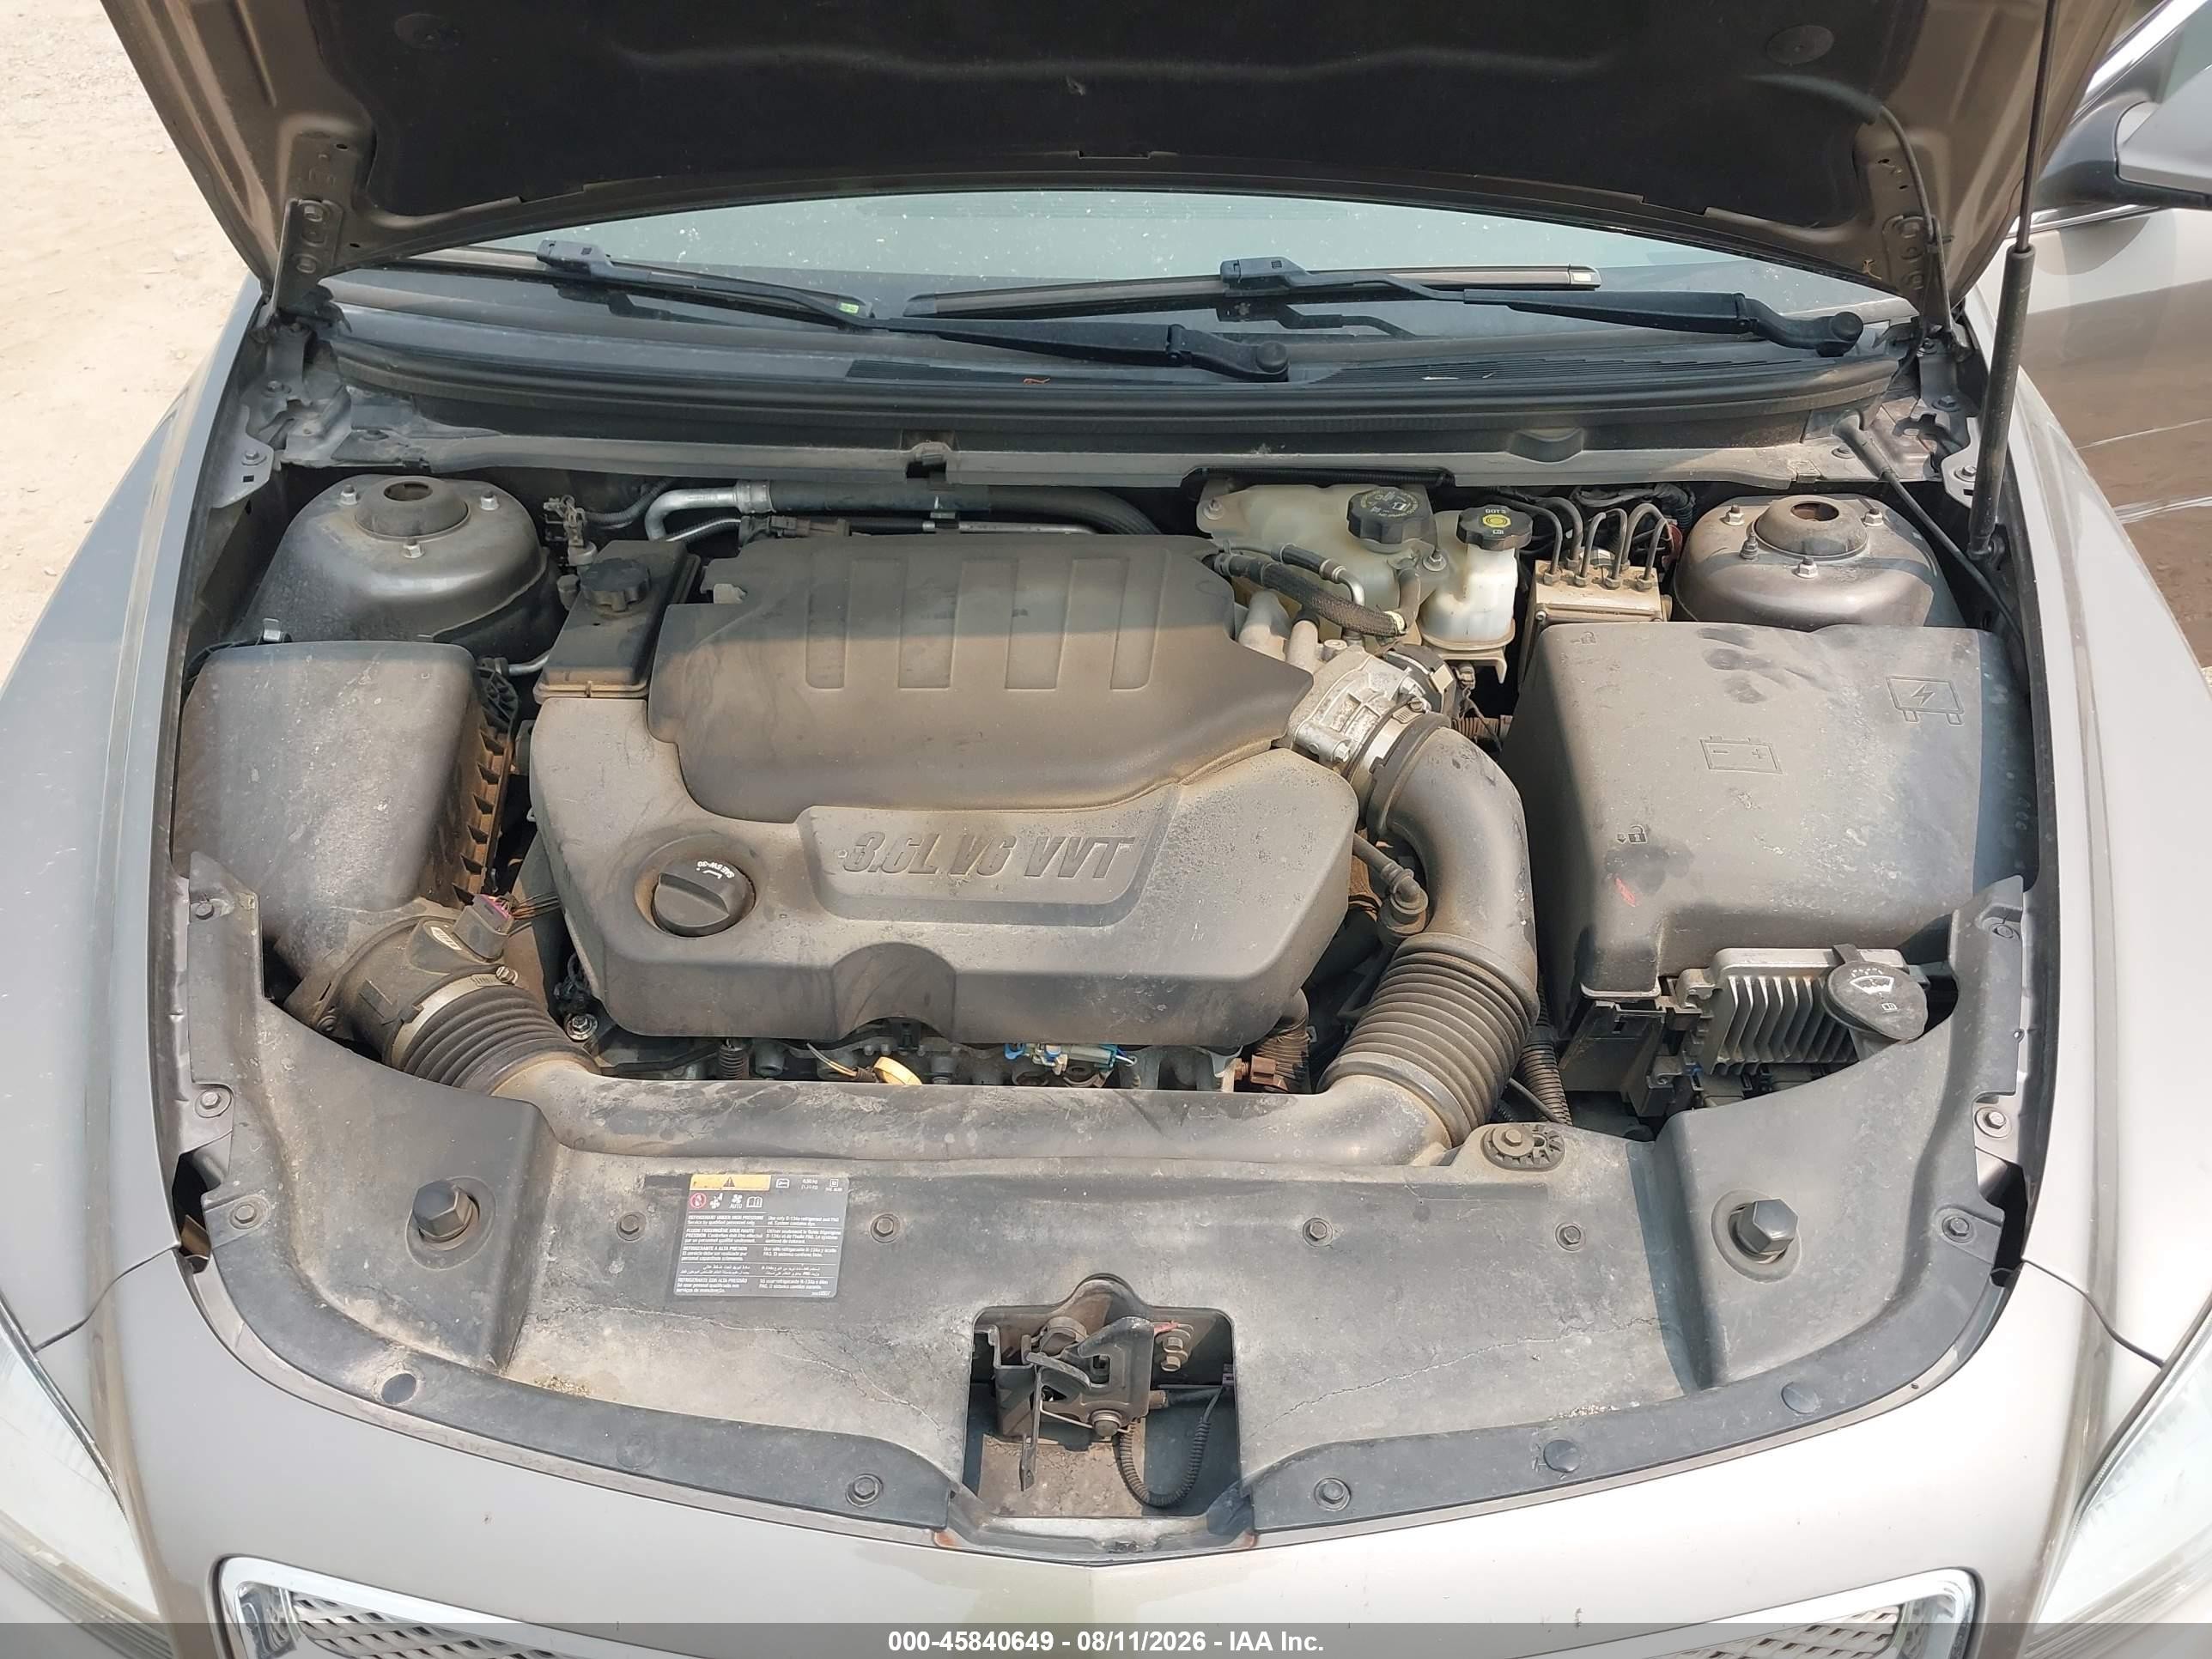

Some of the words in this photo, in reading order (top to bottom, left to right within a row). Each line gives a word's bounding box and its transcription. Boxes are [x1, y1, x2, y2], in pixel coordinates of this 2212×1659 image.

[947, 835, 1017, 877] V6
[1024, 836, 1136, 879] VVT
[720, 866, 735, 878] SAE
